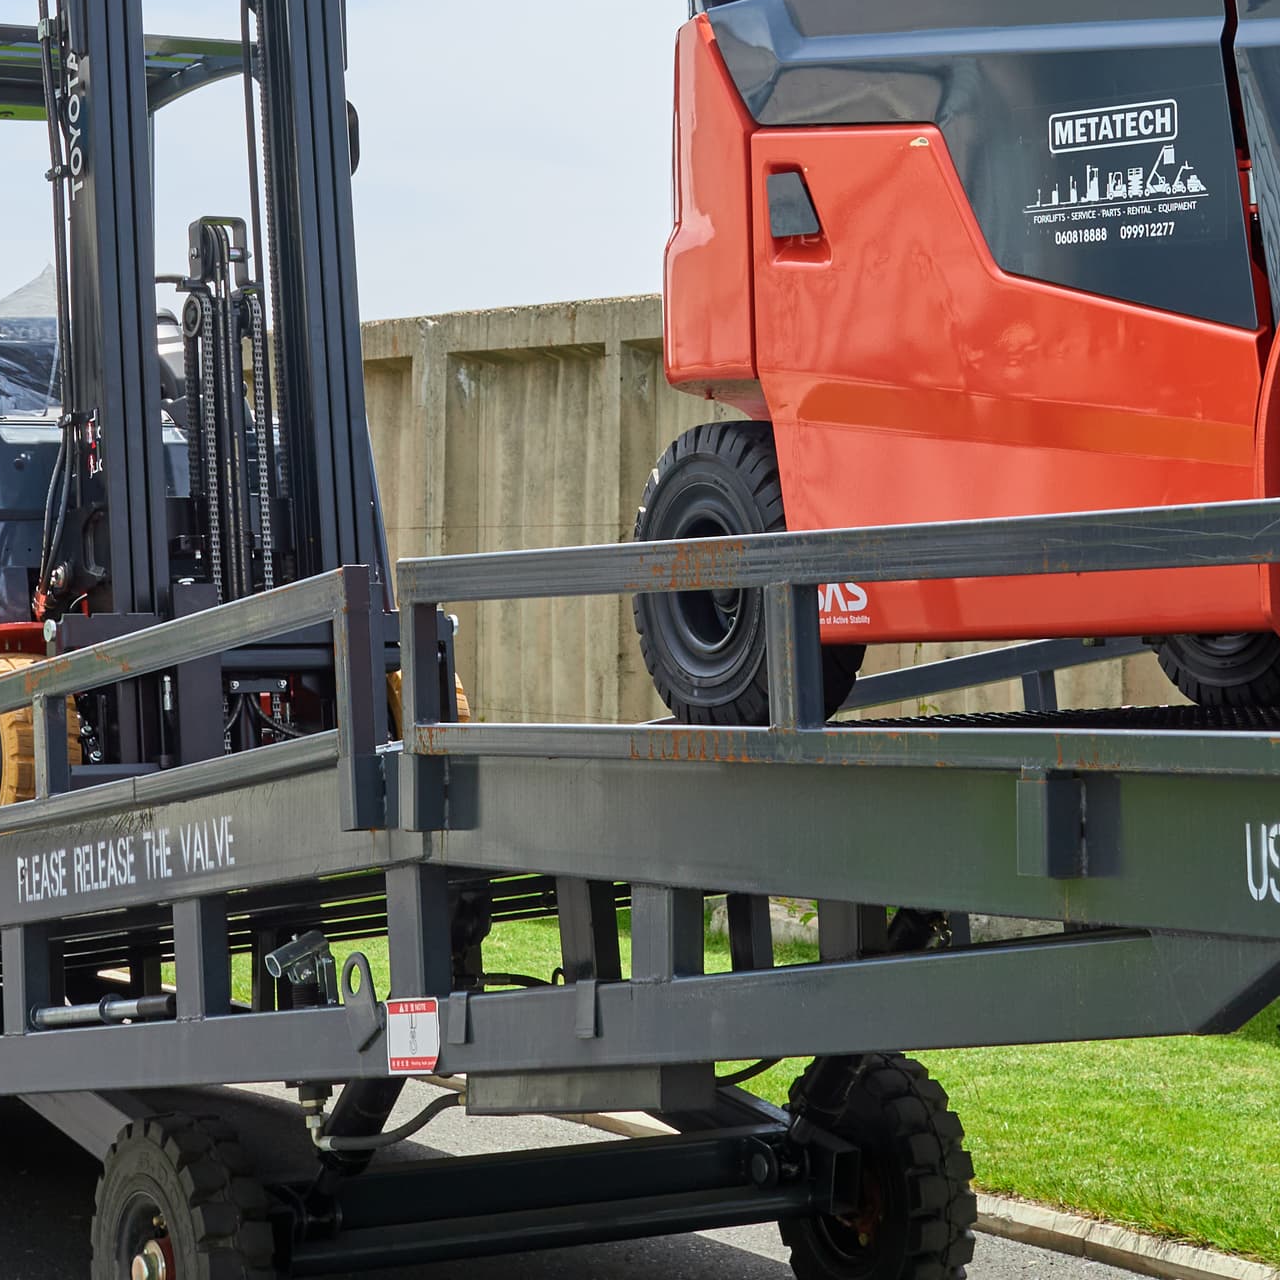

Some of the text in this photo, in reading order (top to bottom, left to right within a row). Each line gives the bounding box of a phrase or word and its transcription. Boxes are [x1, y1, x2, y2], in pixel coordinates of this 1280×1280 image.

[67, 51, 83, 201] TOYOTA
[1054, 107, 1171, 146] METATECH
[1033, 200, 1197, 224] FORKLIFTS SERVICE PARTS RENTAL EQUIPMENT
[1055, 221, 1175, 245] 060818888 099912277
[818, 583, 868, 612] AS
[832, 615, 848, 624] Active
[849, 615, 870, 625] Stability
[17, 816, 235, 903] PLEASE RELEASE THE VALVE
